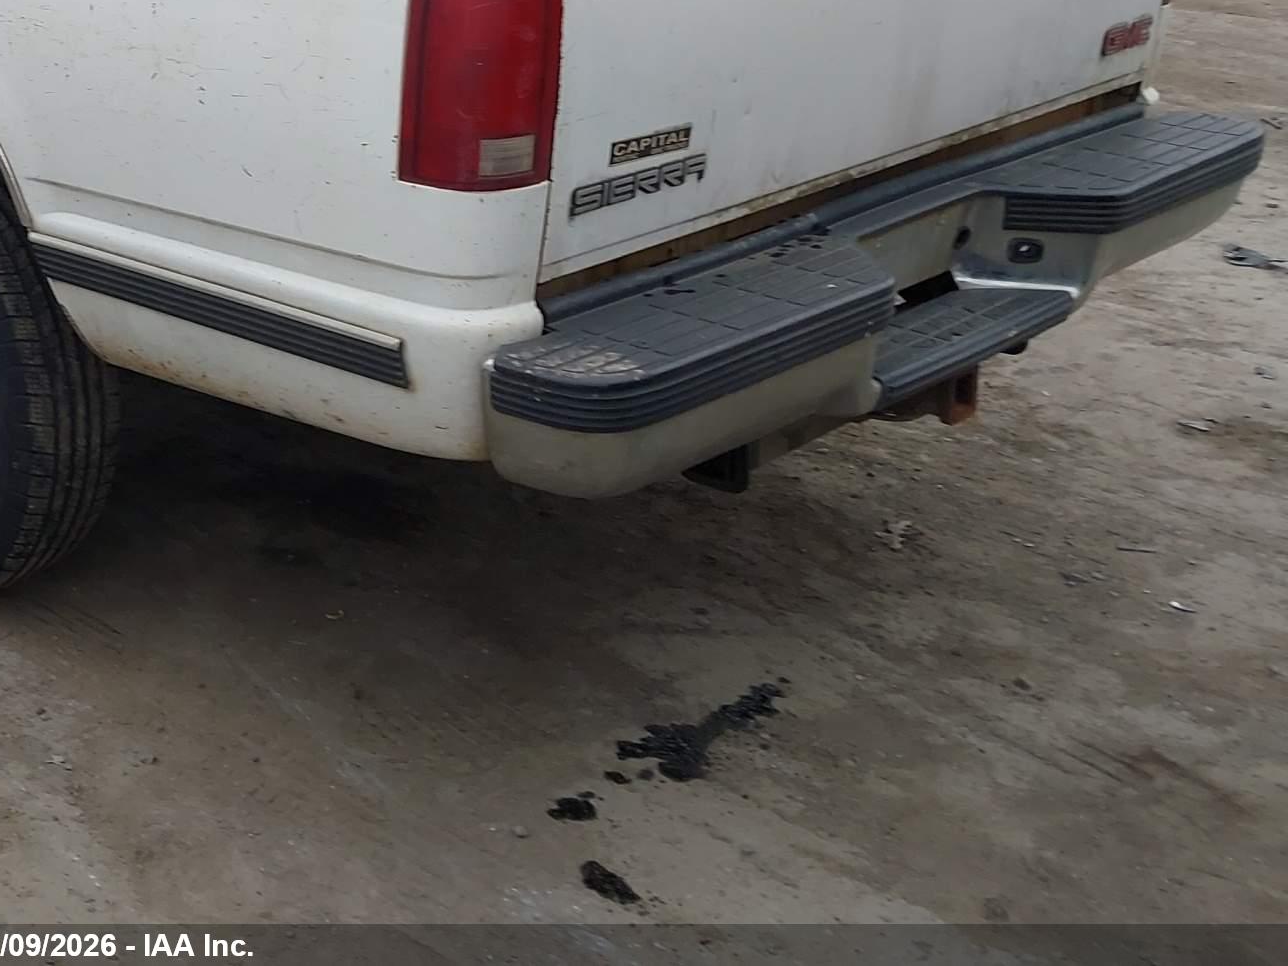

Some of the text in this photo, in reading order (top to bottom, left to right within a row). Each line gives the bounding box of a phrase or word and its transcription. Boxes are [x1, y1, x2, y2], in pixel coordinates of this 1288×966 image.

[1100, 16, 1153, 56] GMC
[613, 130, 689, 156] CAPITAL
[569, 153, 706, 217] SIERRA
